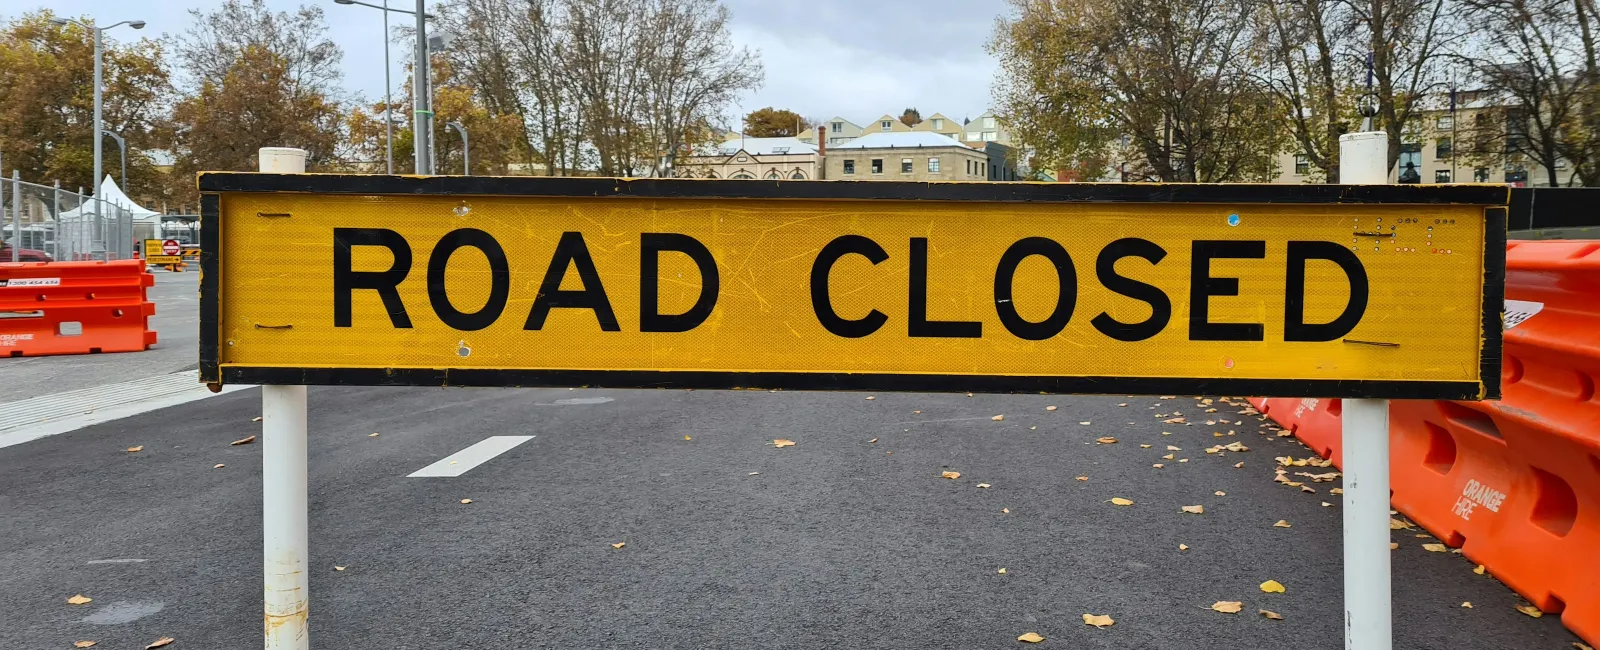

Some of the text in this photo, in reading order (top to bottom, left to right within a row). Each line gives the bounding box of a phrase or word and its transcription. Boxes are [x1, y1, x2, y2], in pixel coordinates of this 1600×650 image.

[334, 228, 1368, 342] ROAD CLOSED
[1451, 495, 1478, 520] HIRE
[1463, 479, 1506, 512] ORANGE
